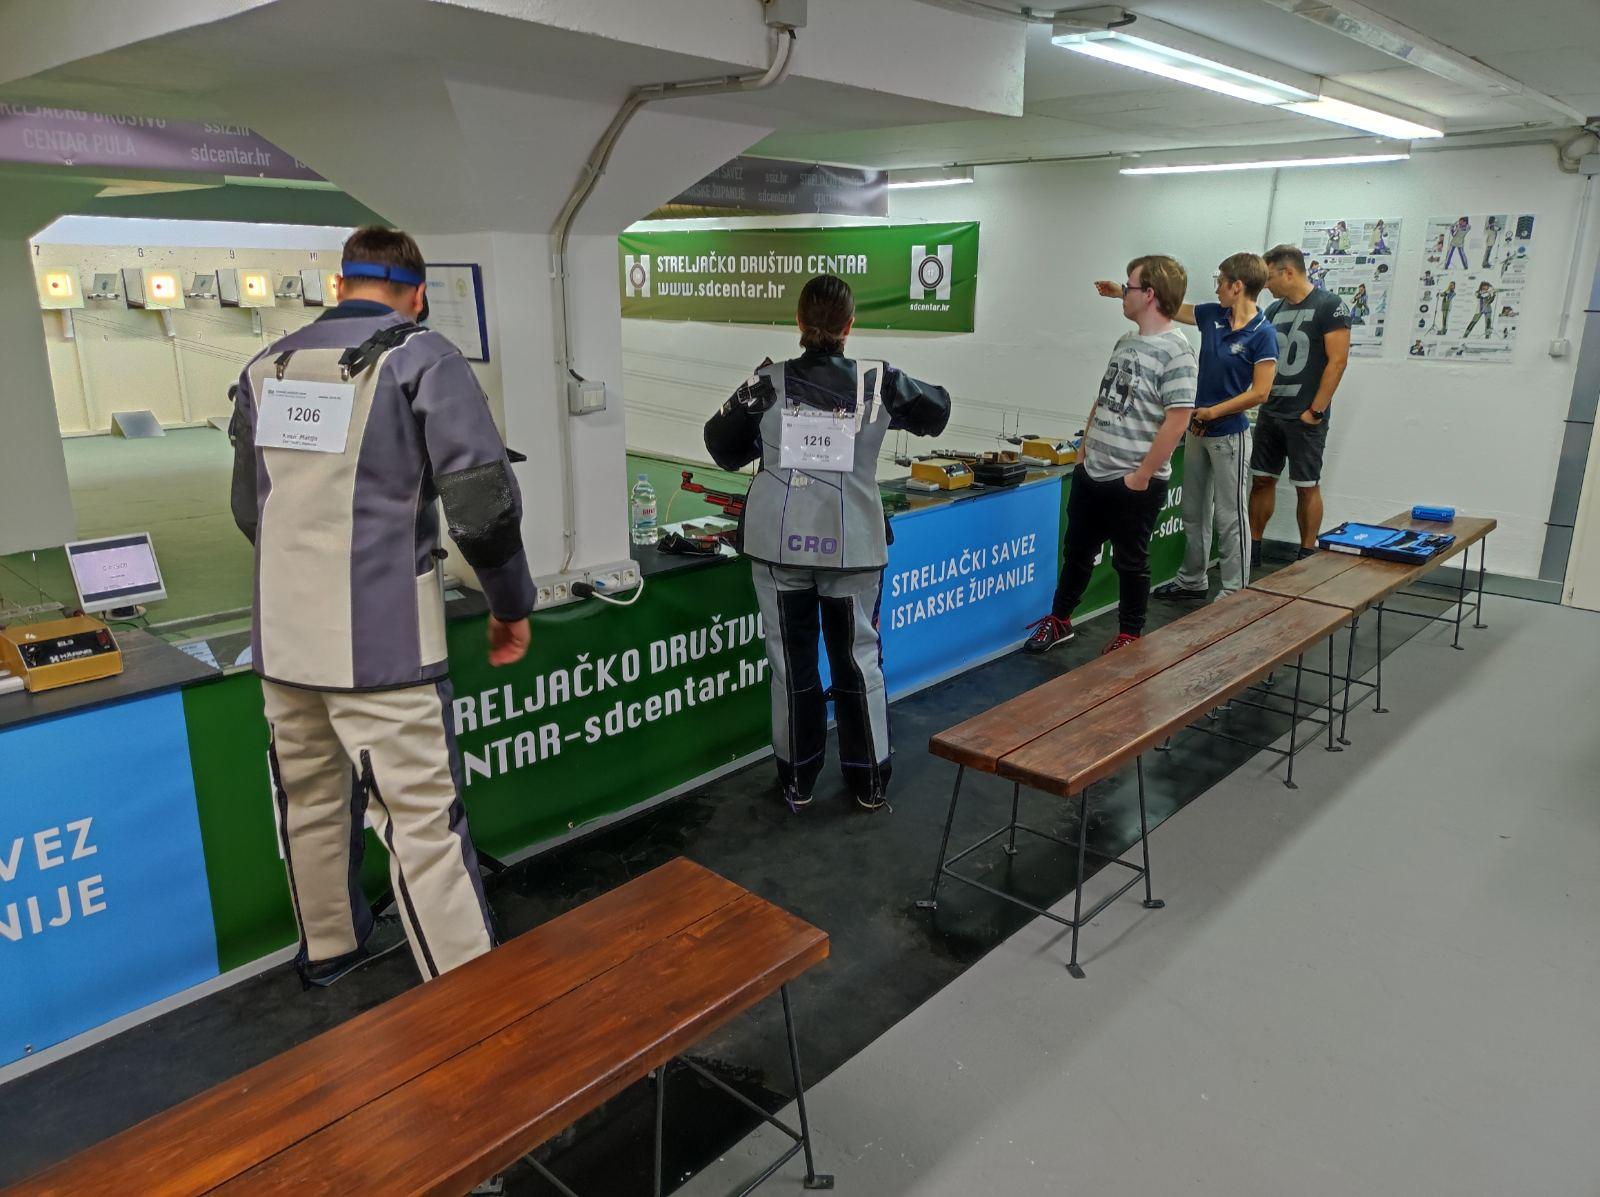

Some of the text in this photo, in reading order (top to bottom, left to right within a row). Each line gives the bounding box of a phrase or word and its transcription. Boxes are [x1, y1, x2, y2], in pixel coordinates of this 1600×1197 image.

[23, 127, 137, 156] CENTAR PULA
[190, 143, 271, 167] sdcentar.hr
[34, 244, 41, 256] 7
[137, 247, 144, 258] 8
[229, 249, 236, 260] 9
[657, 251, 868, 275] STRELJAČKO DRUŠTVO CENTAR
[657, 279, 786, 299] www.sdcentar.hr
[909, 302, 950, 313] sdcentar.hr
[287, 407, 321, 423] 1206
[803, 435, 831, 447] 1216
[787, 534, 838, 555] CRO
[892, 533, 1036, 598] STRELJAČKI SAVEZ
[891, 562, 1035, 631] ISTARSKE ŽUPANIJE
[452, 652, 640, 736] RELJAČKO
[464, 657, 769, 787] NTAR-sdcentar.hr
